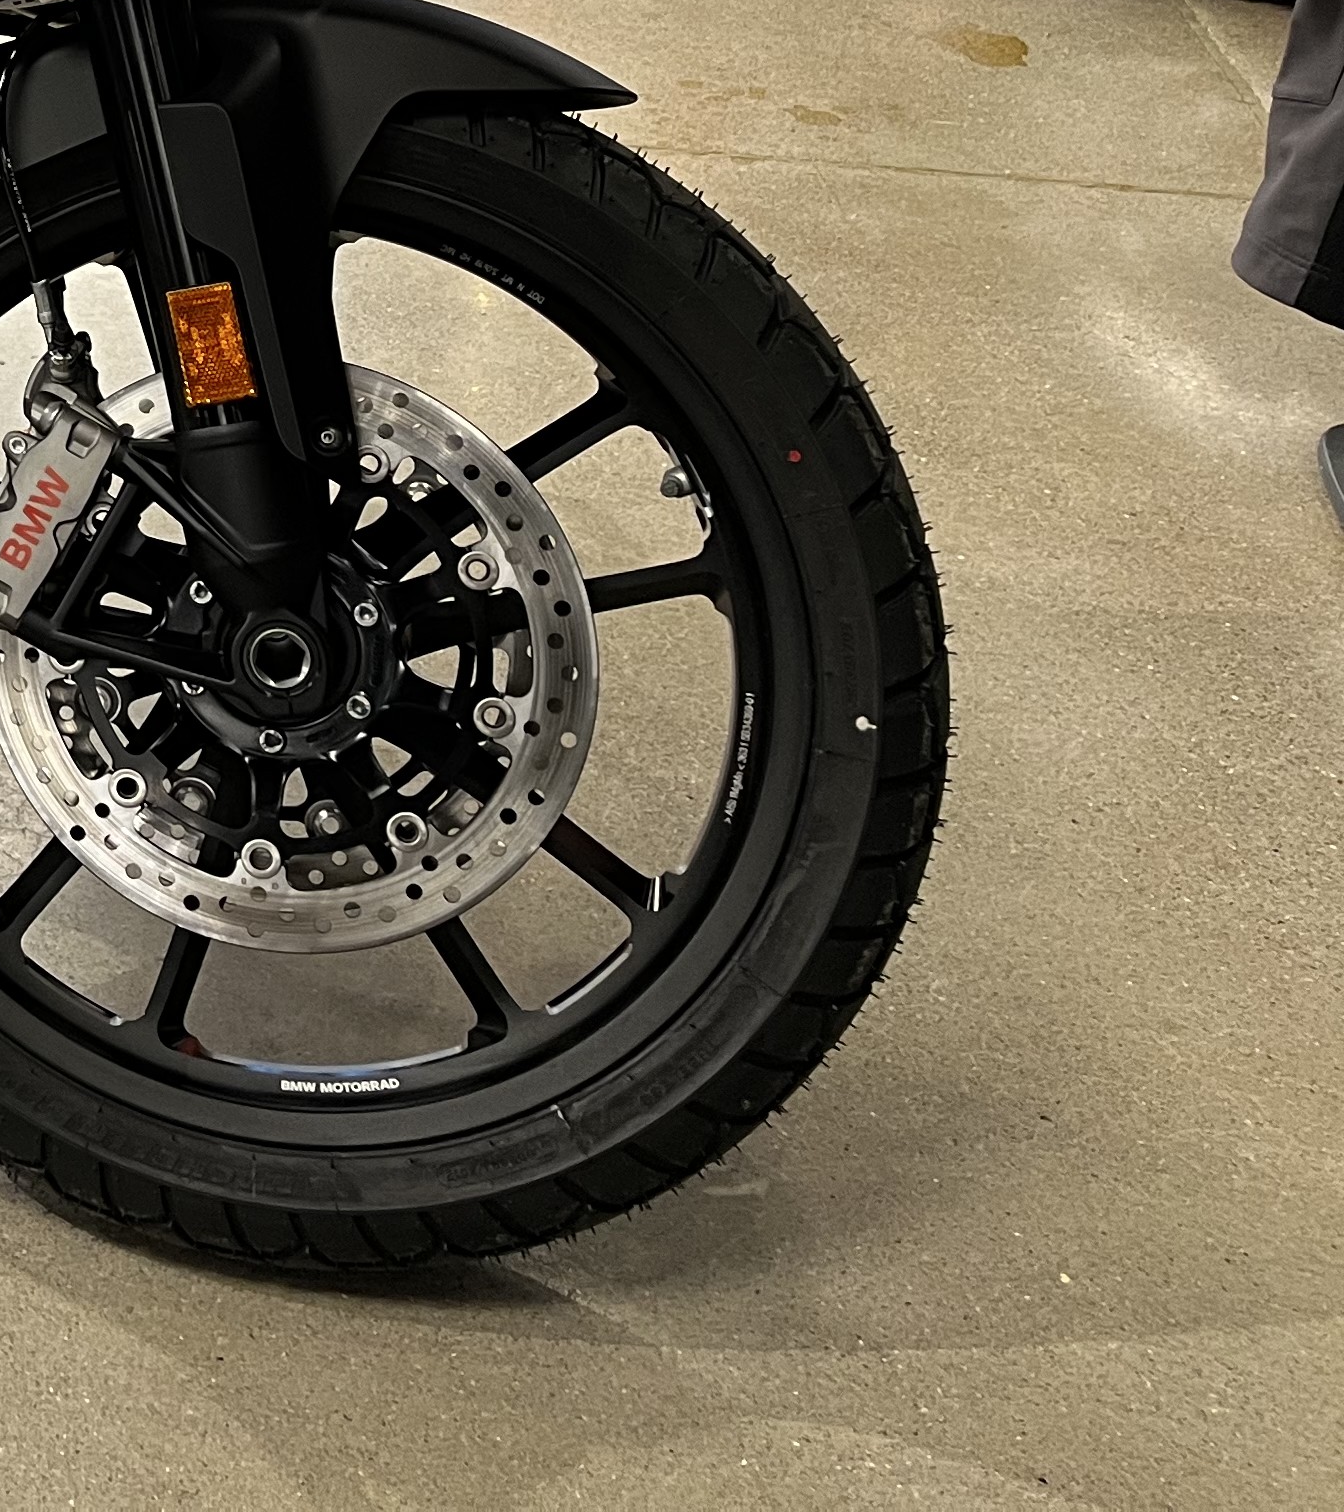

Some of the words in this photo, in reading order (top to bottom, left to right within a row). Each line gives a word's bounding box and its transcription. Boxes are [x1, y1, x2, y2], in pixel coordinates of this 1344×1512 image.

[0, 464, 70, 571] BMW
[280, 1079, 317, 1093] BMW
[319, 1077, 401, 1094] MOTORRAD
